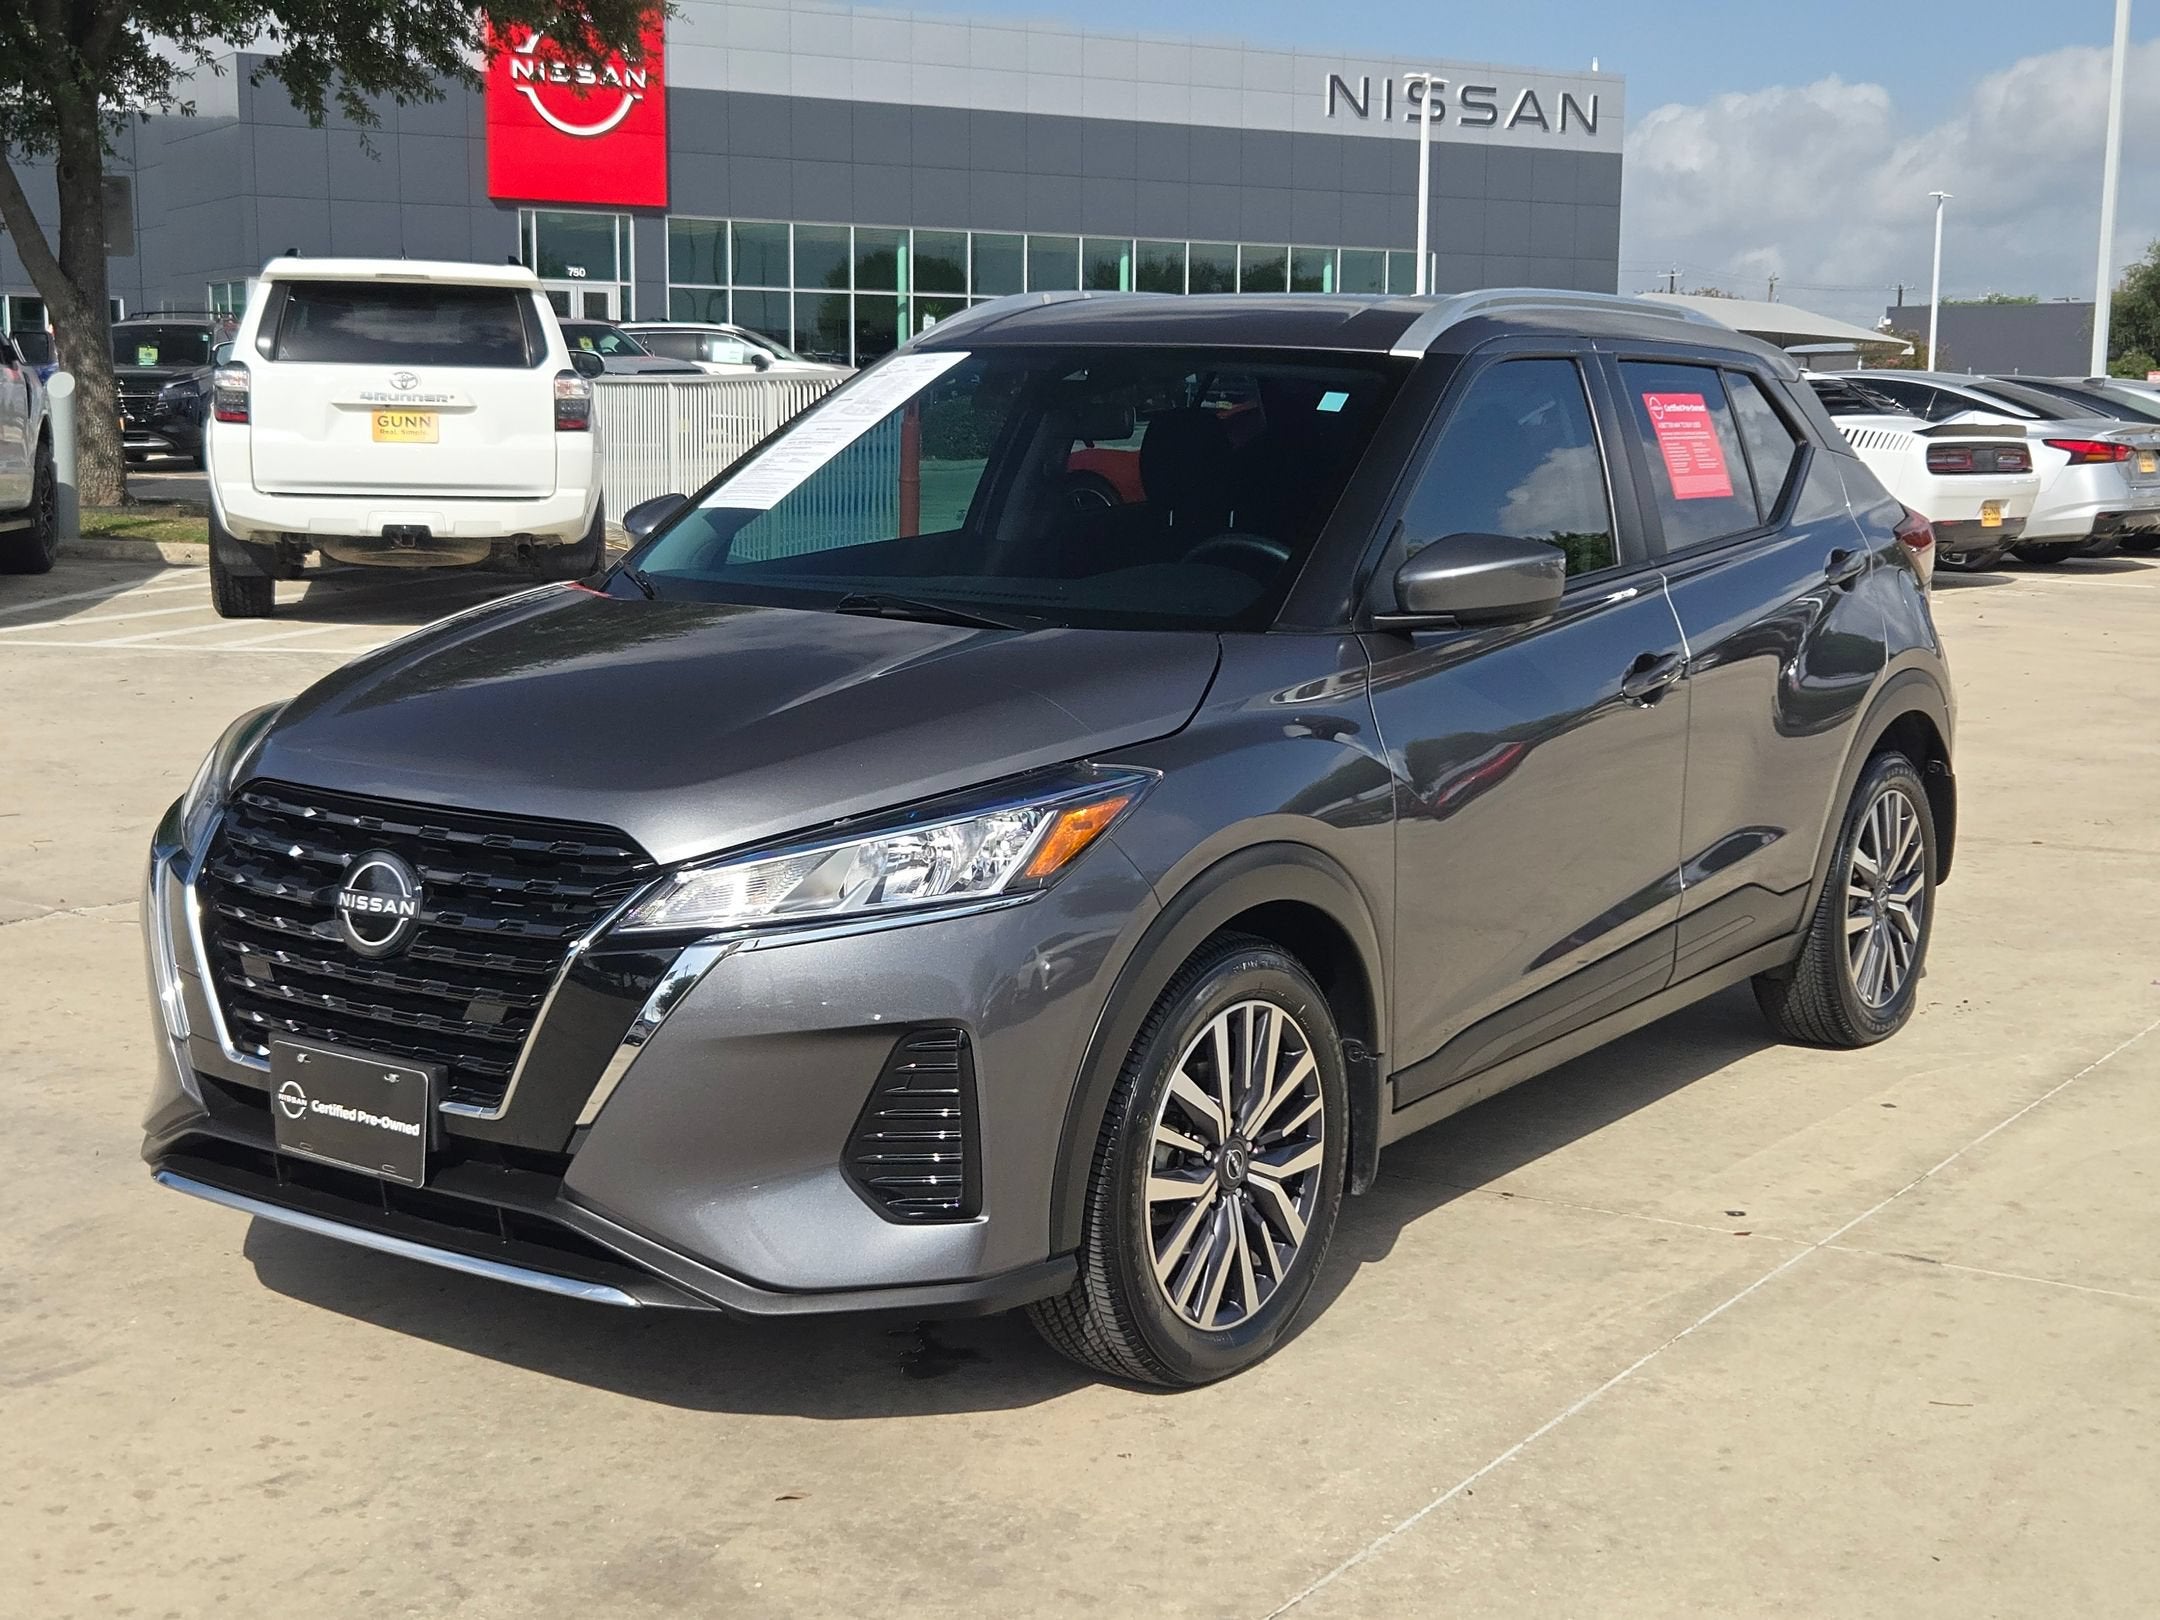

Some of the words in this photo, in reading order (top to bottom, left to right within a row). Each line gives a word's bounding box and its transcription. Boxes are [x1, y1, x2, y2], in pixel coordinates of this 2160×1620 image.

[511, 59, 647, 88] NISSAN
[1325, 72, 1599, 136] NISSAN
[567, 267, 586, 278] 750
[377, 415, 431, 428] GUNN
[339, 891, 416, 915] NISSAN
[278, 1093, 308, 1107] NISSAN
[311, 1100, 357, 1121] Certified
[358, 1111, 421, 1137] Pre-Owned
